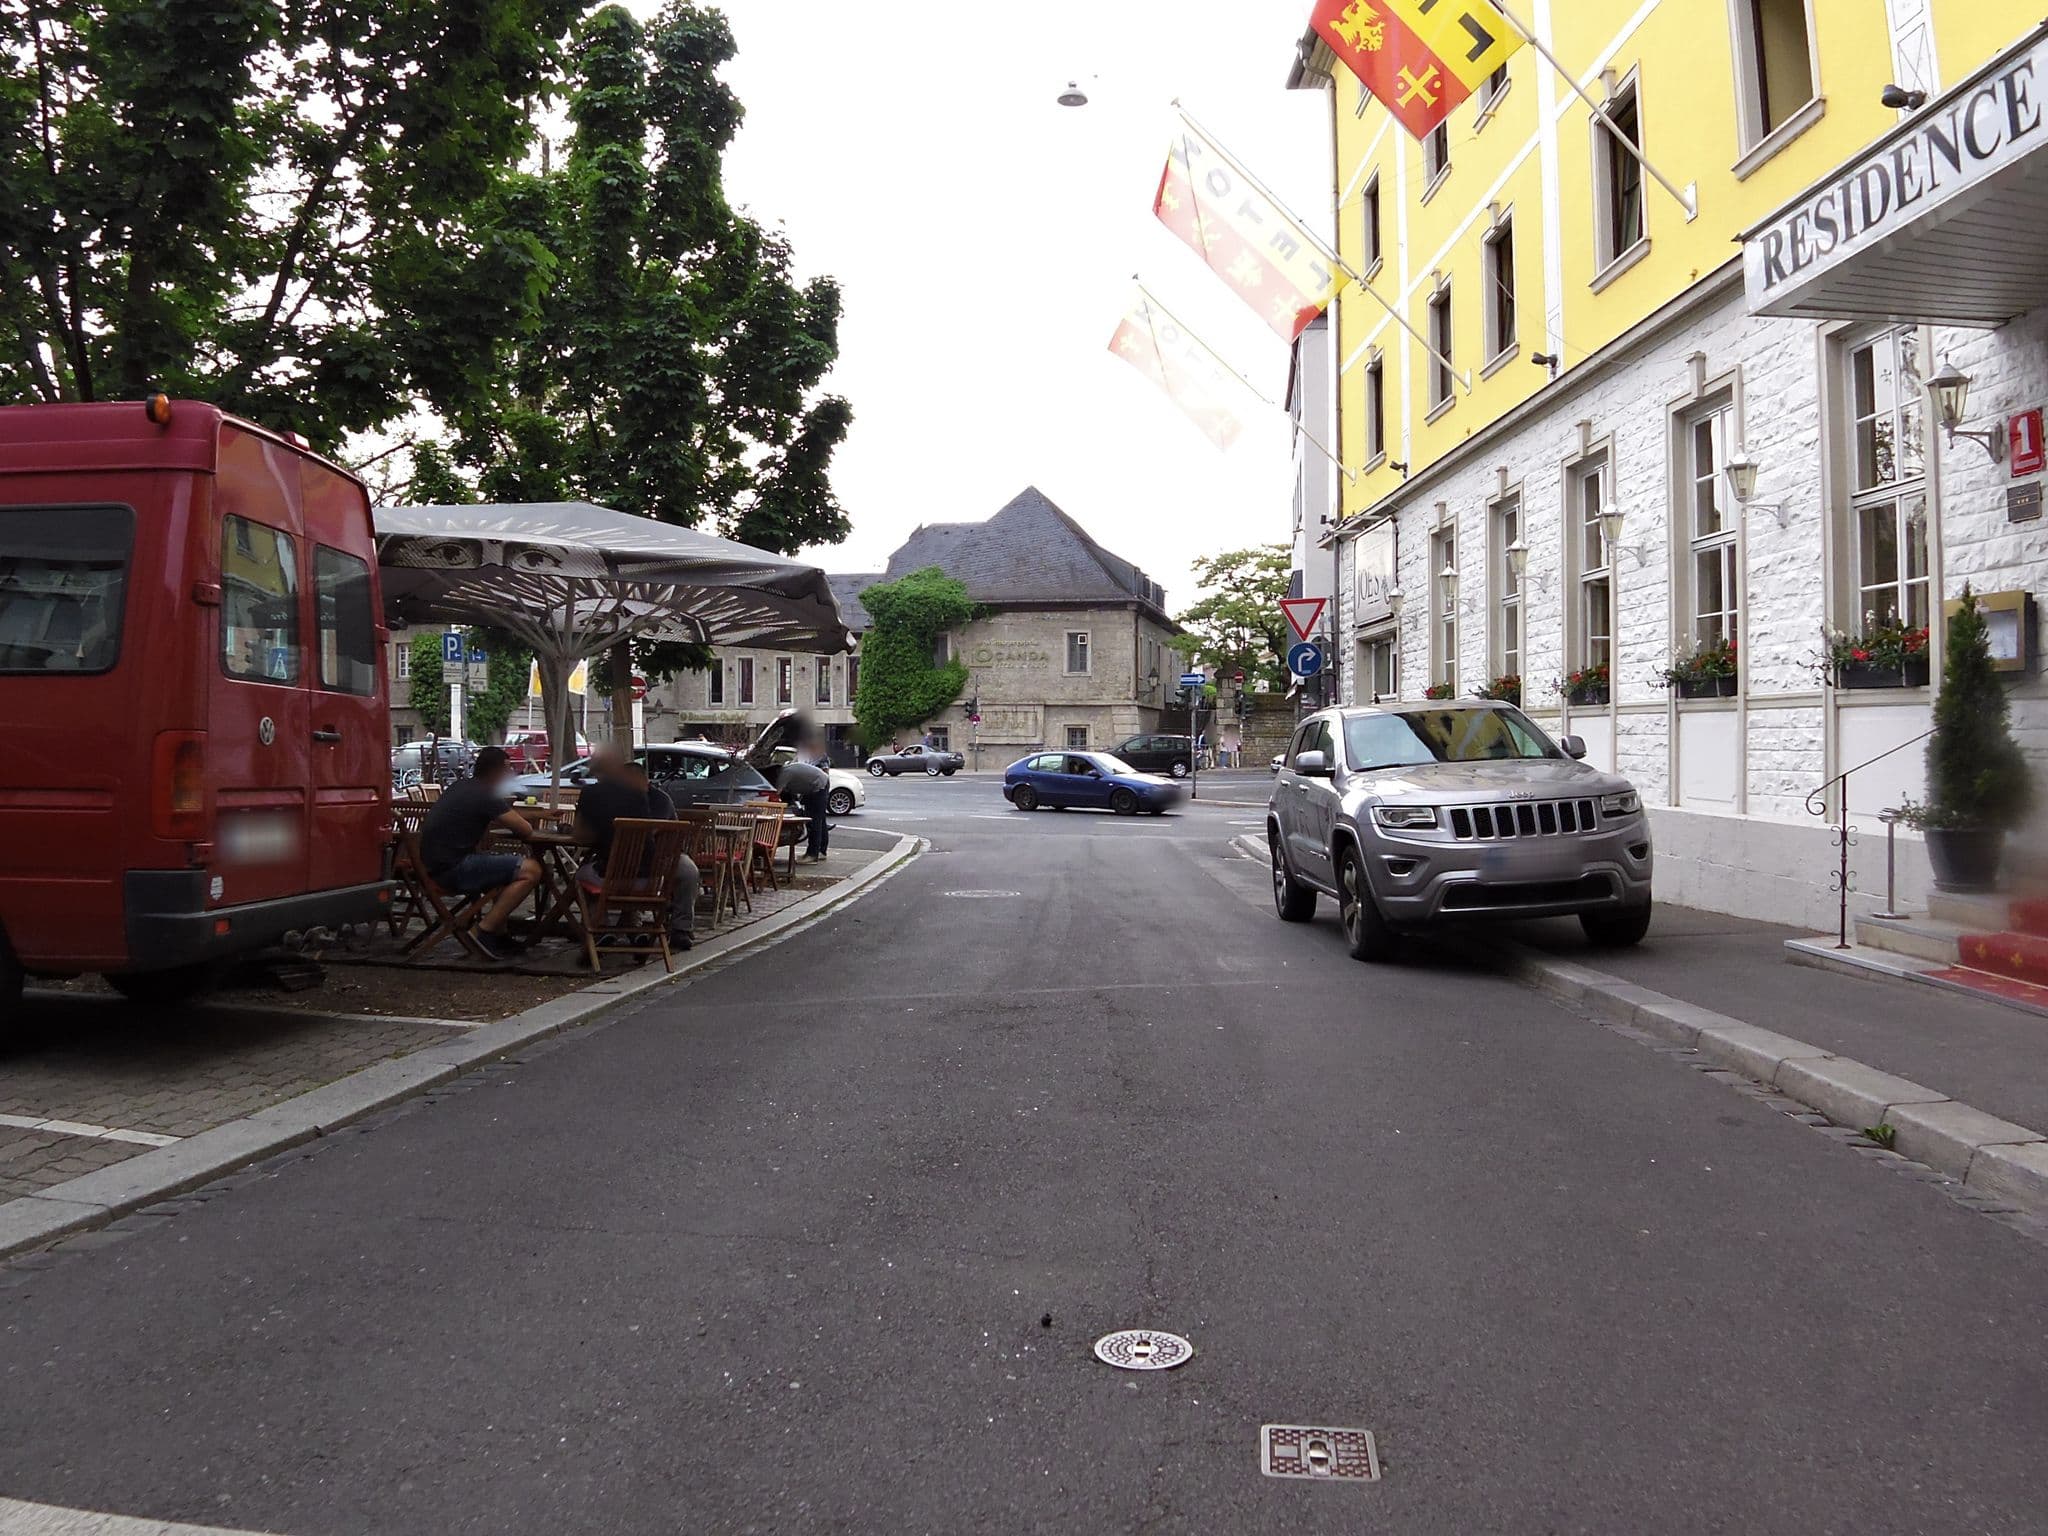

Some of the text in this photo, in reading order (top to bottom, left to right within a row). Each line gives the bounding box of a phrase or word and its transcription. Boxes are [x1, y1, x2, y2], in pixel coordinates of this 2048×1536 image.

[1759, 57, 2042, 293] RESIDENCE
[2016, 415, 2033, 456] 1
[447, 636, 458, 660] P
[1507, 789, 1535, 800] Jeep
